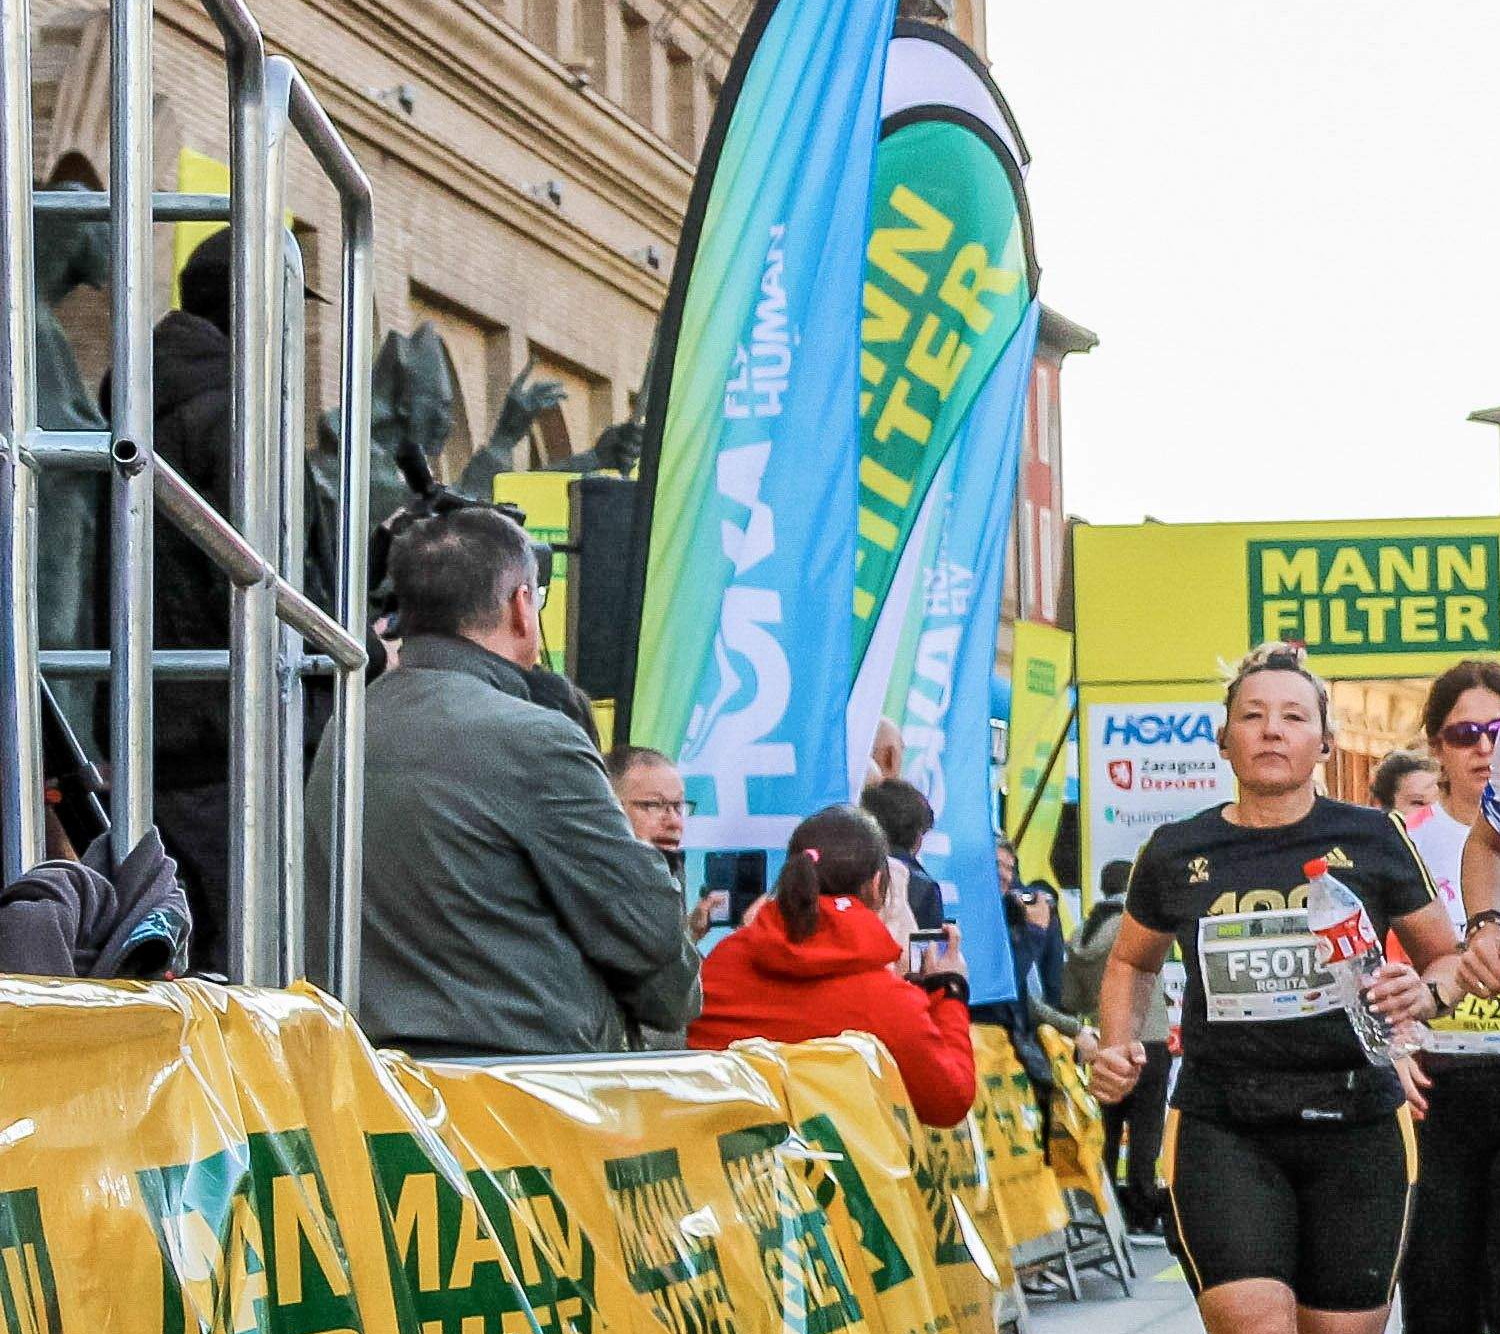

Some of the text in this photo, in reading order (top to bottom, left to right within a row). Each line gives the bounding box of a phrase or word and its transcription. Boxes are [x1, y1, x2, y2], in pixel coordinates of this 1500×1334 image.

[1261, 544, 1489, 596] MANN
[1262, 595, 1490, 646] FILTER
[1104, 714, 1217, 746] HOKA
